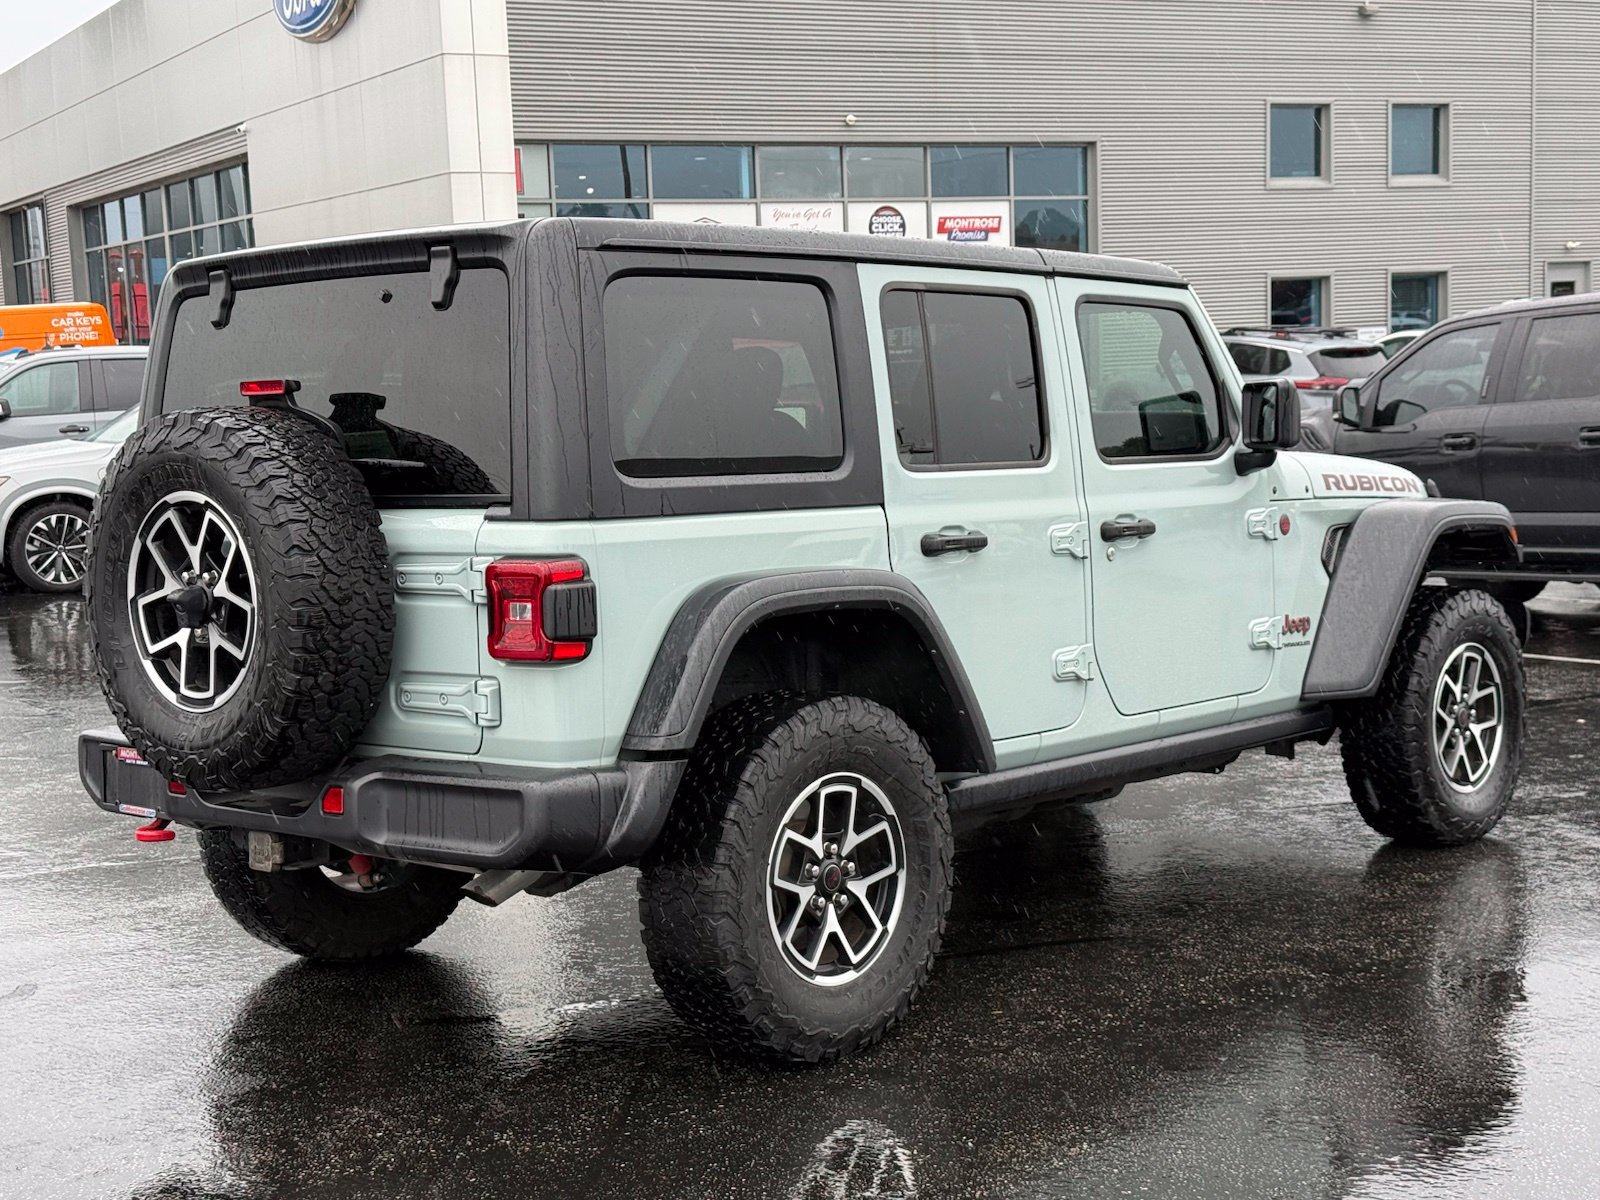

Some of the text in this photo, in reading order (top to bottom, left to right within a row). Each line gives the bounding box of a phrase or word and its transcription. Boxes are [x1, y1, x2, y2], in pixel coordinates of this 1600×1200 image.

[773, 208, 833, 222] You've Got A
[871, 223, 904, 232] CLICK.
[943, 217, 1000, 229] MONTROSE
[950, 229, 986, 240] Promise
[51, 316, 102, 327] CAR KEYS
[1321, 474, 1420, 493] RUBICON
[1282, 614, 1310, 637] Jeep
